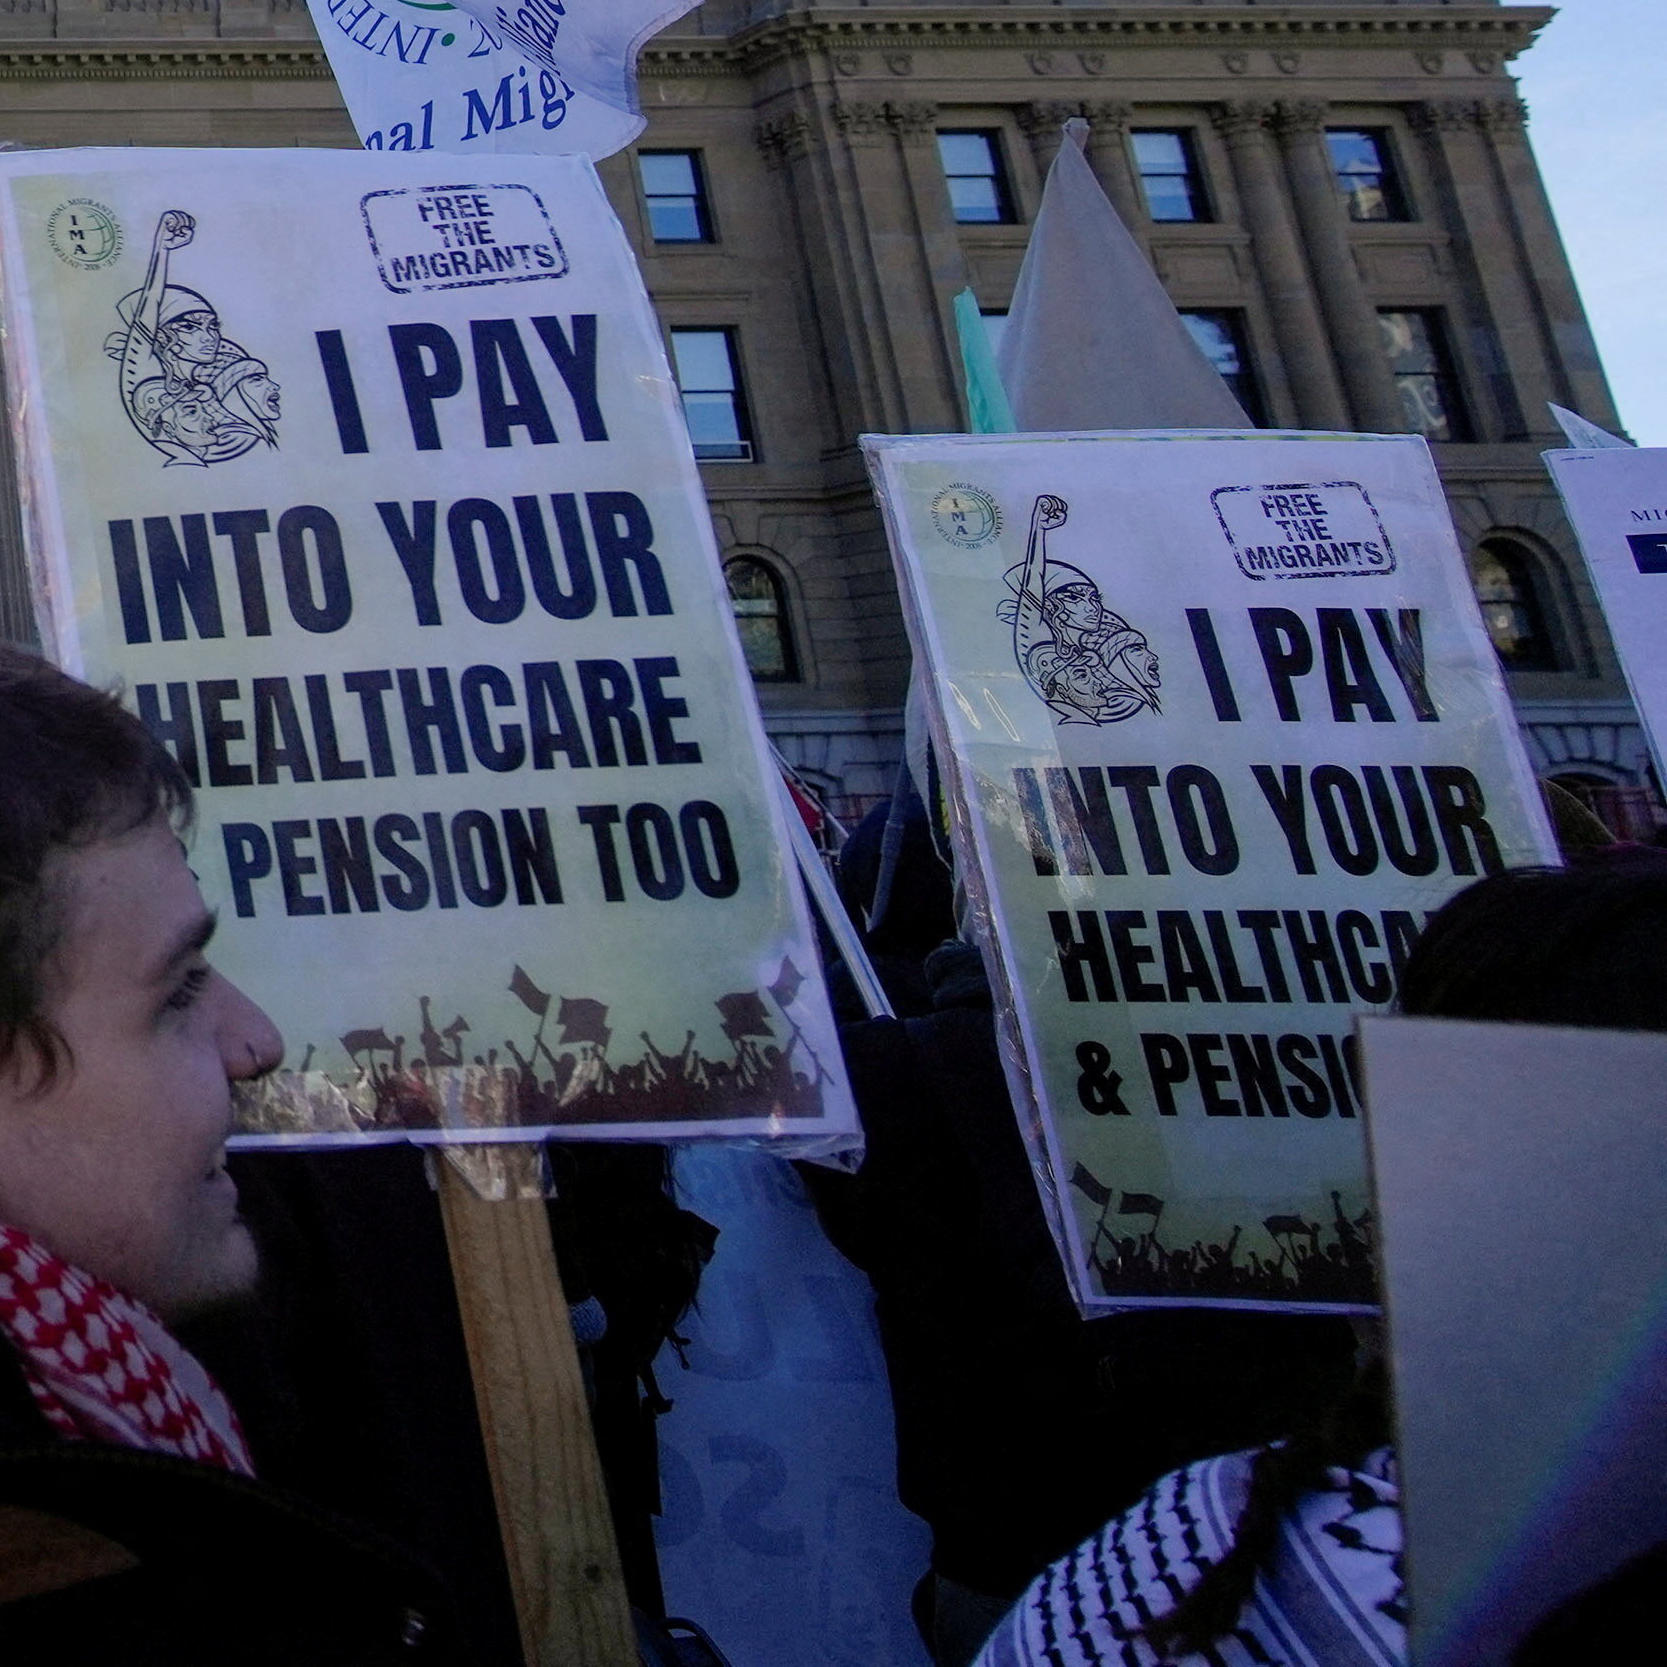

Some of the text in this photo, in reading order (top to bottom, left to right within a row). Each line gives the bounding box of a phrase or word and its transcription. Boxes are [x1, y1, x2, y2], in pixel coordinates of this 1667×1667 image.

[364, 100, 434, 150] nal
[417, 194, 494, 222] FREE
[433, 221, 495, 248] THE
[391, 244, 555, 282] MIGRANTS
[315, 314, 610, 454] I PAY
[1260, 493, 1328, 517] FREE
[1275, 518, 1329, 542] THE
[107, 490, 674, 645] INTO YOUR
[1243, 541, 1385, 571] MIGRANTS
[1185, 607, 1441, 722] I PAY
[136, 655, 702, 788] HEALTHCARE
[221, 800, 740, 918] PENSION TOO
[1011, 764, 1505, 877] INTO YOUR
[1047, 909, 1433, 1004] HEALTHCA
[1075, 1033, 1365, 1119] & PENSI
